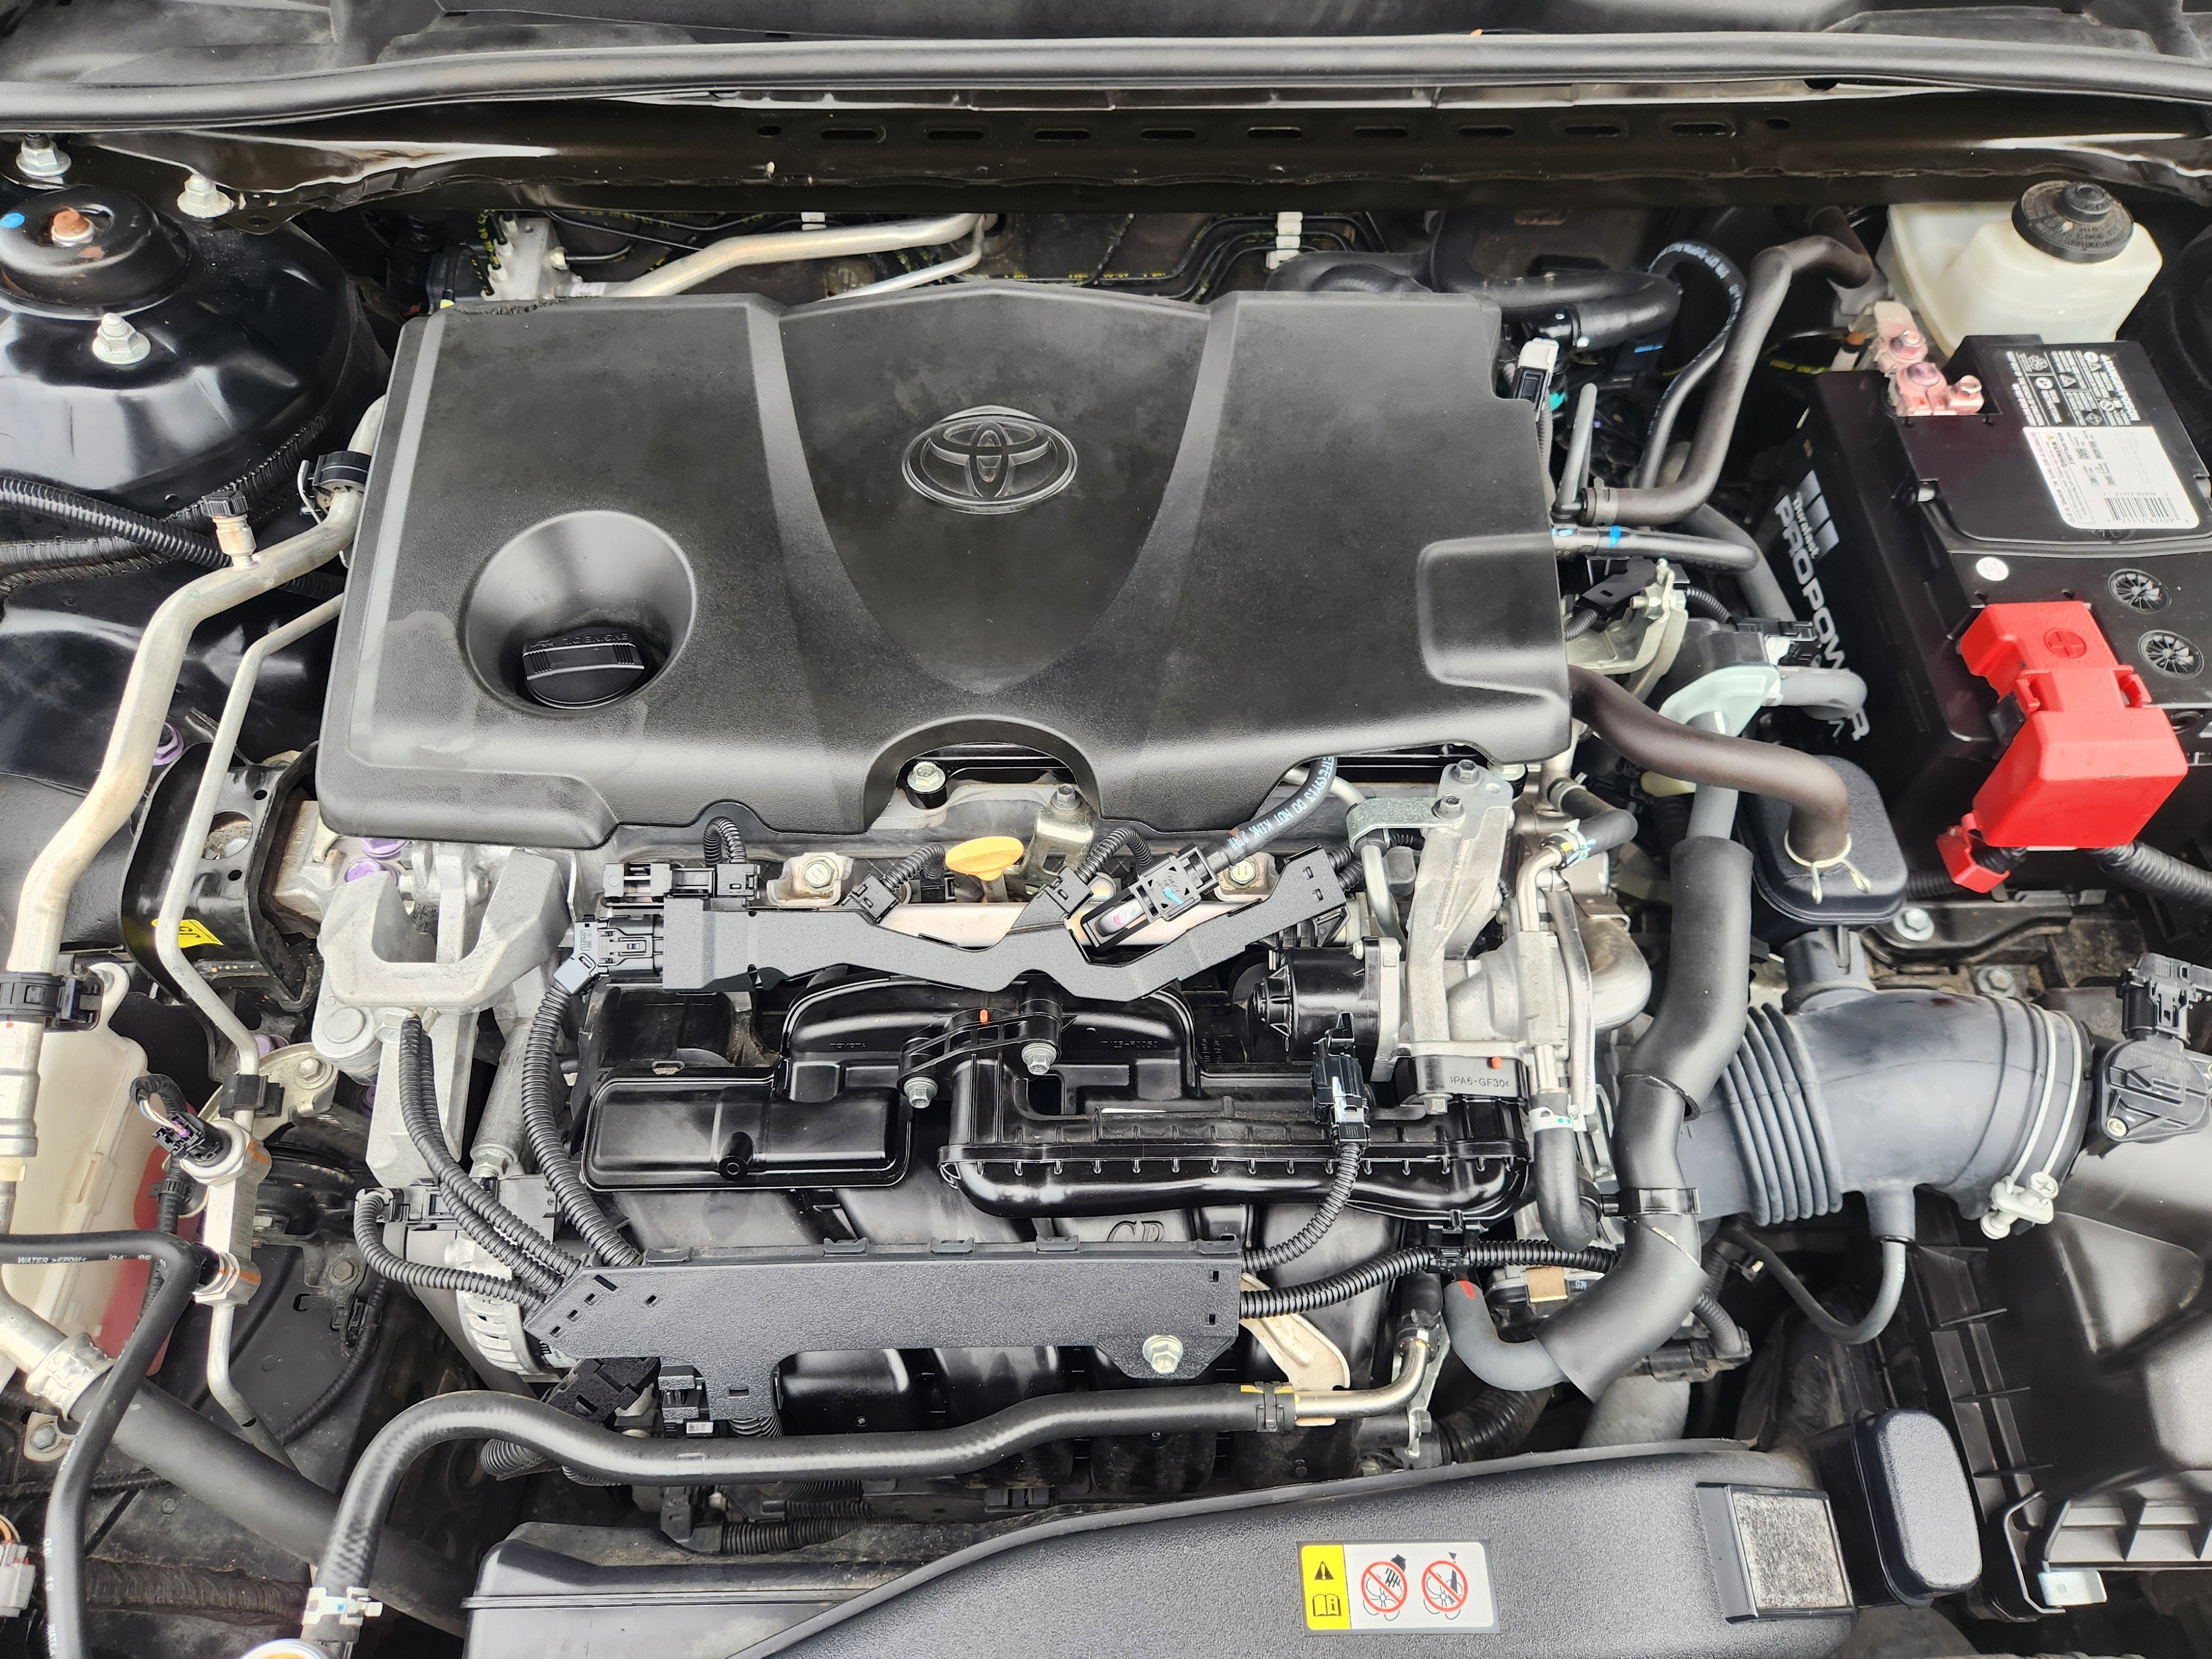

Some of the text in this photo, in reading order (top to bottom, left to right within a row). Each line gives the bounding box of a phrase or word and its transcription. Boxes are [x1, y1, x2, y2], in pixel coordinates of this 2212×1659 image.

[1775, 496, 1870, 742] PROPOWR
[585, 632, 629, 644] ENGINE
[1290, 798, 1308, 814] DO
[1274, 808, 1293, 826] NOT
[1248, 818, 1274, 839] KINK
